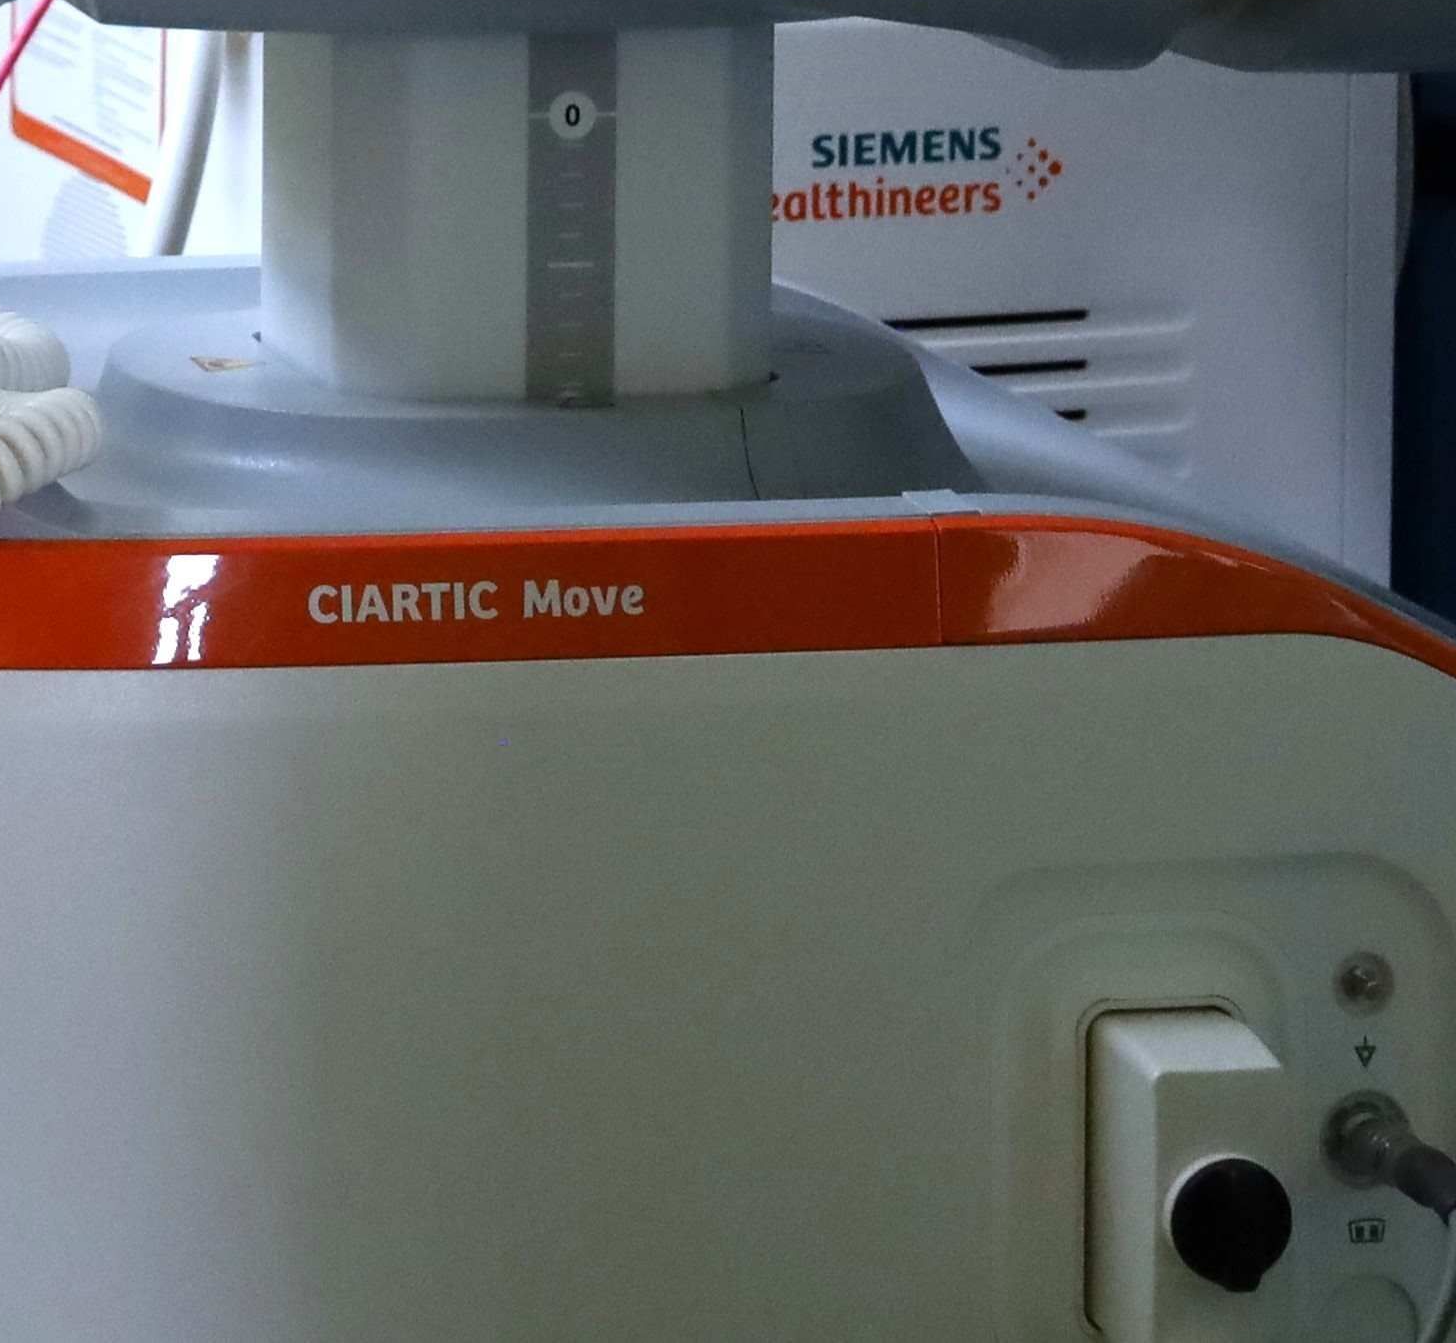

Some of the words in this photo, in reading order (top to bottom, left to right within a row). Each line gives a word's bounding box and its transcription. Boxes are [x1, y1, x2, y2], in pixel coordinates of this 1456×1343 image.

[564, 103, 581, 127] 0
[810, 126, 1003, 169] SIEMENS
[770, 175, 1004, 223] althineers
[307, 580, 500, 625] CIARTIC
[522, 579, 646, 619] Move
